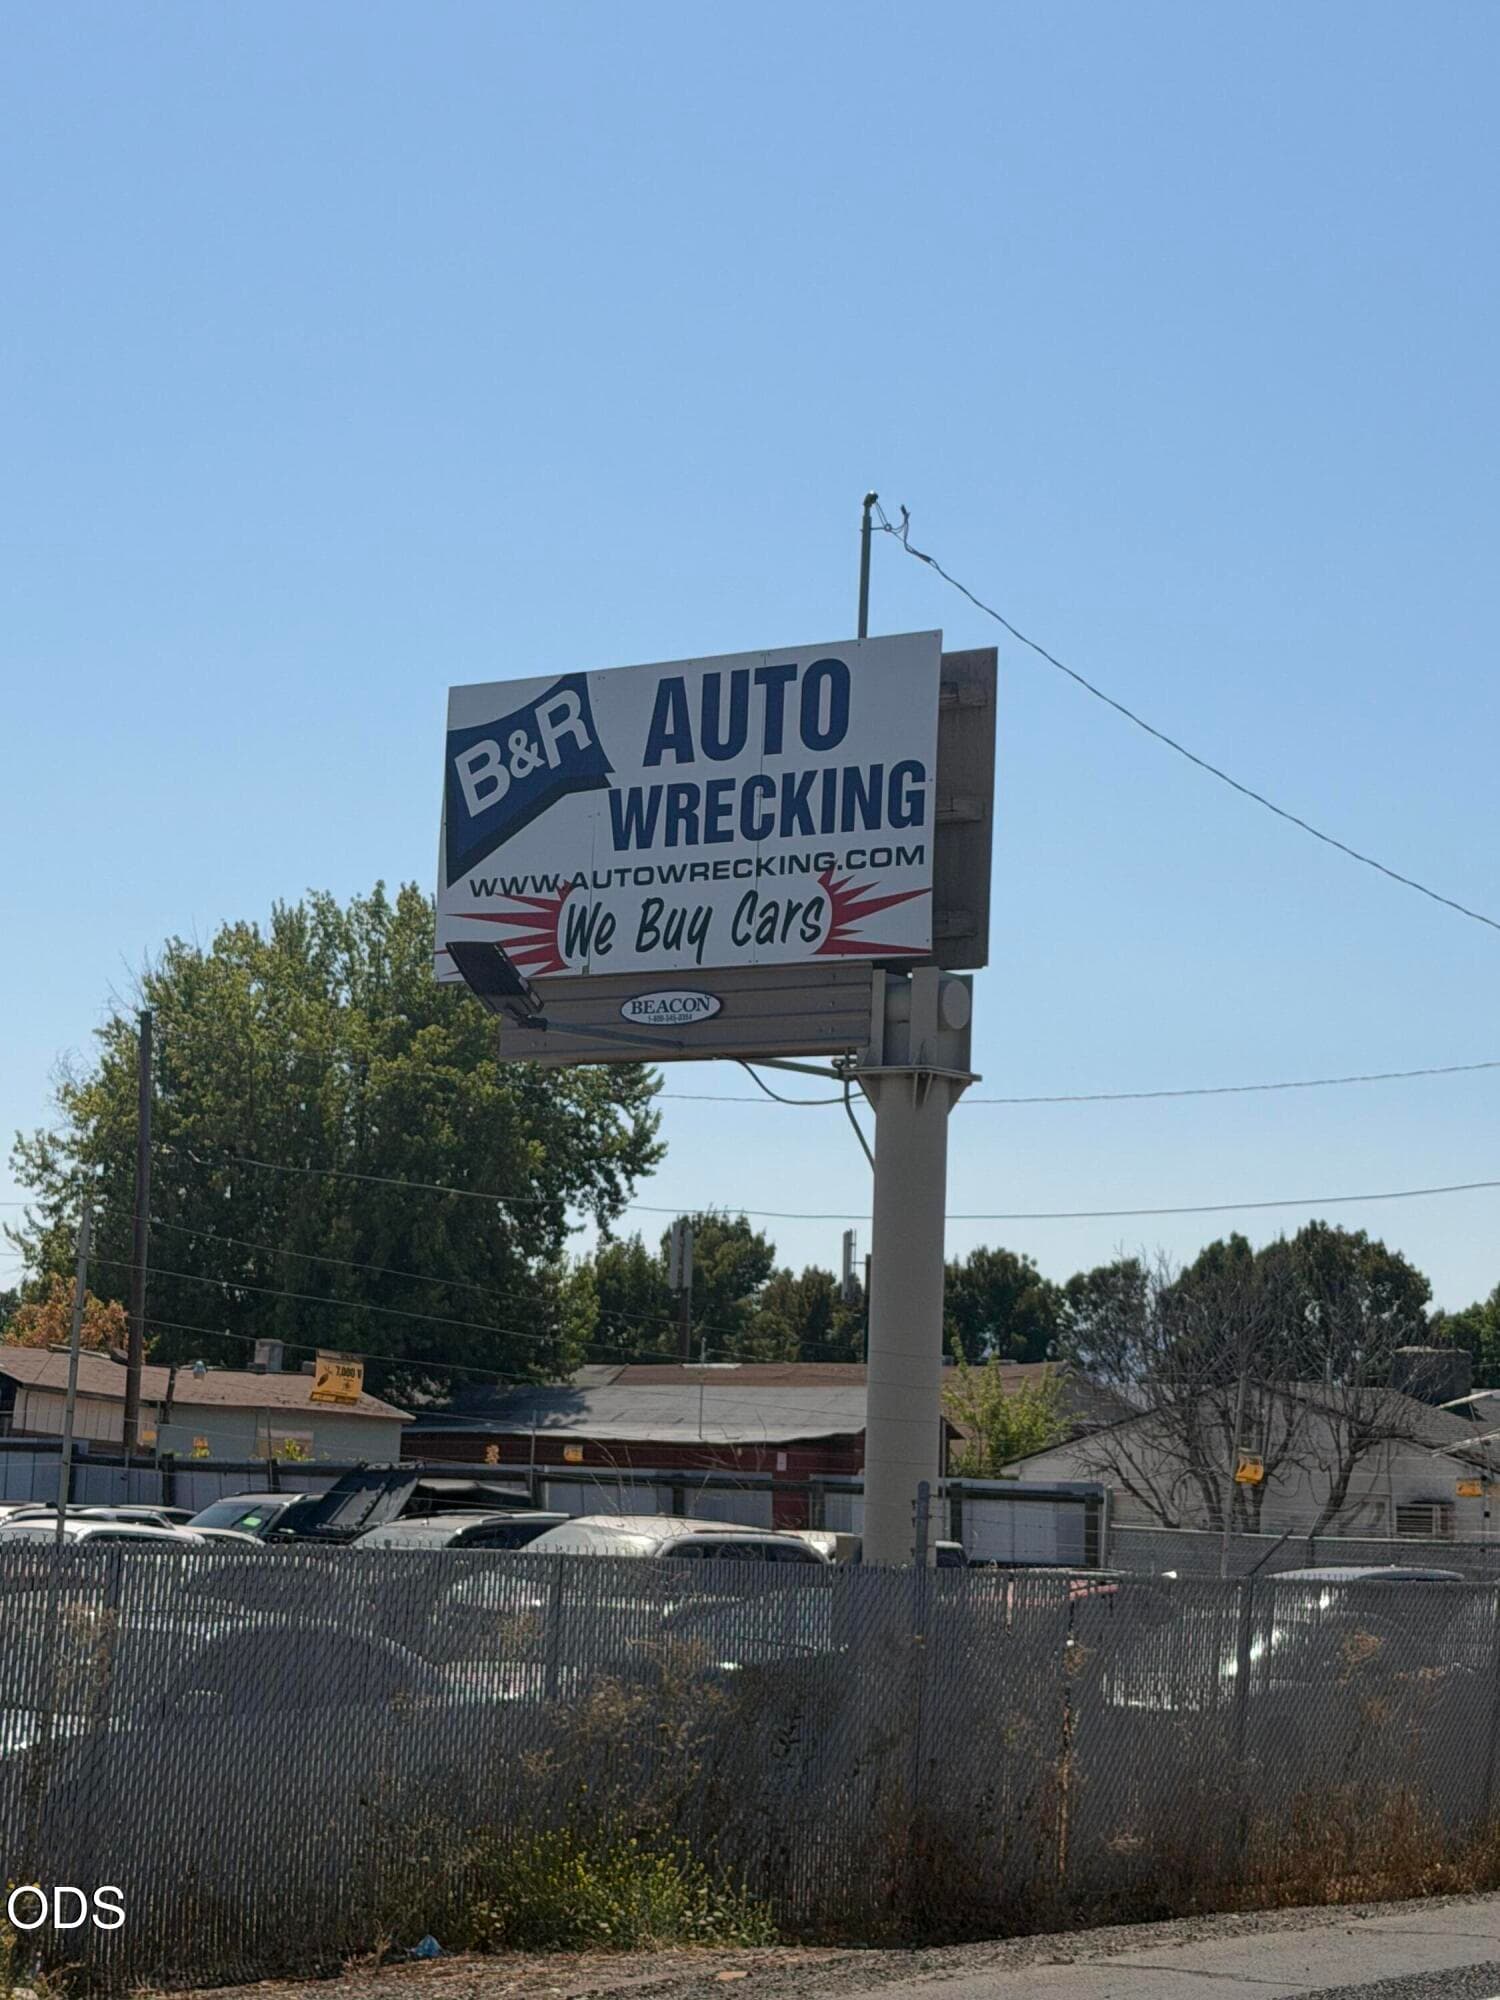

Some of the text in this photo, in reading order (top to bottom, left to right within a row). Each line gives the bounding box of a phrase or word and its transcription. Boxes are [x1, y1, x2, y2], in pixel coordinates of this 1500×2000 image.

[453, 688, 593, 819] B&R
[642, 658, 852, 768] AUTO
[607, 759, 927, 852] WRECKING
[564, 889, 826, 965] We Buy Cars
[631, 997, 711, 1015] BEACON
